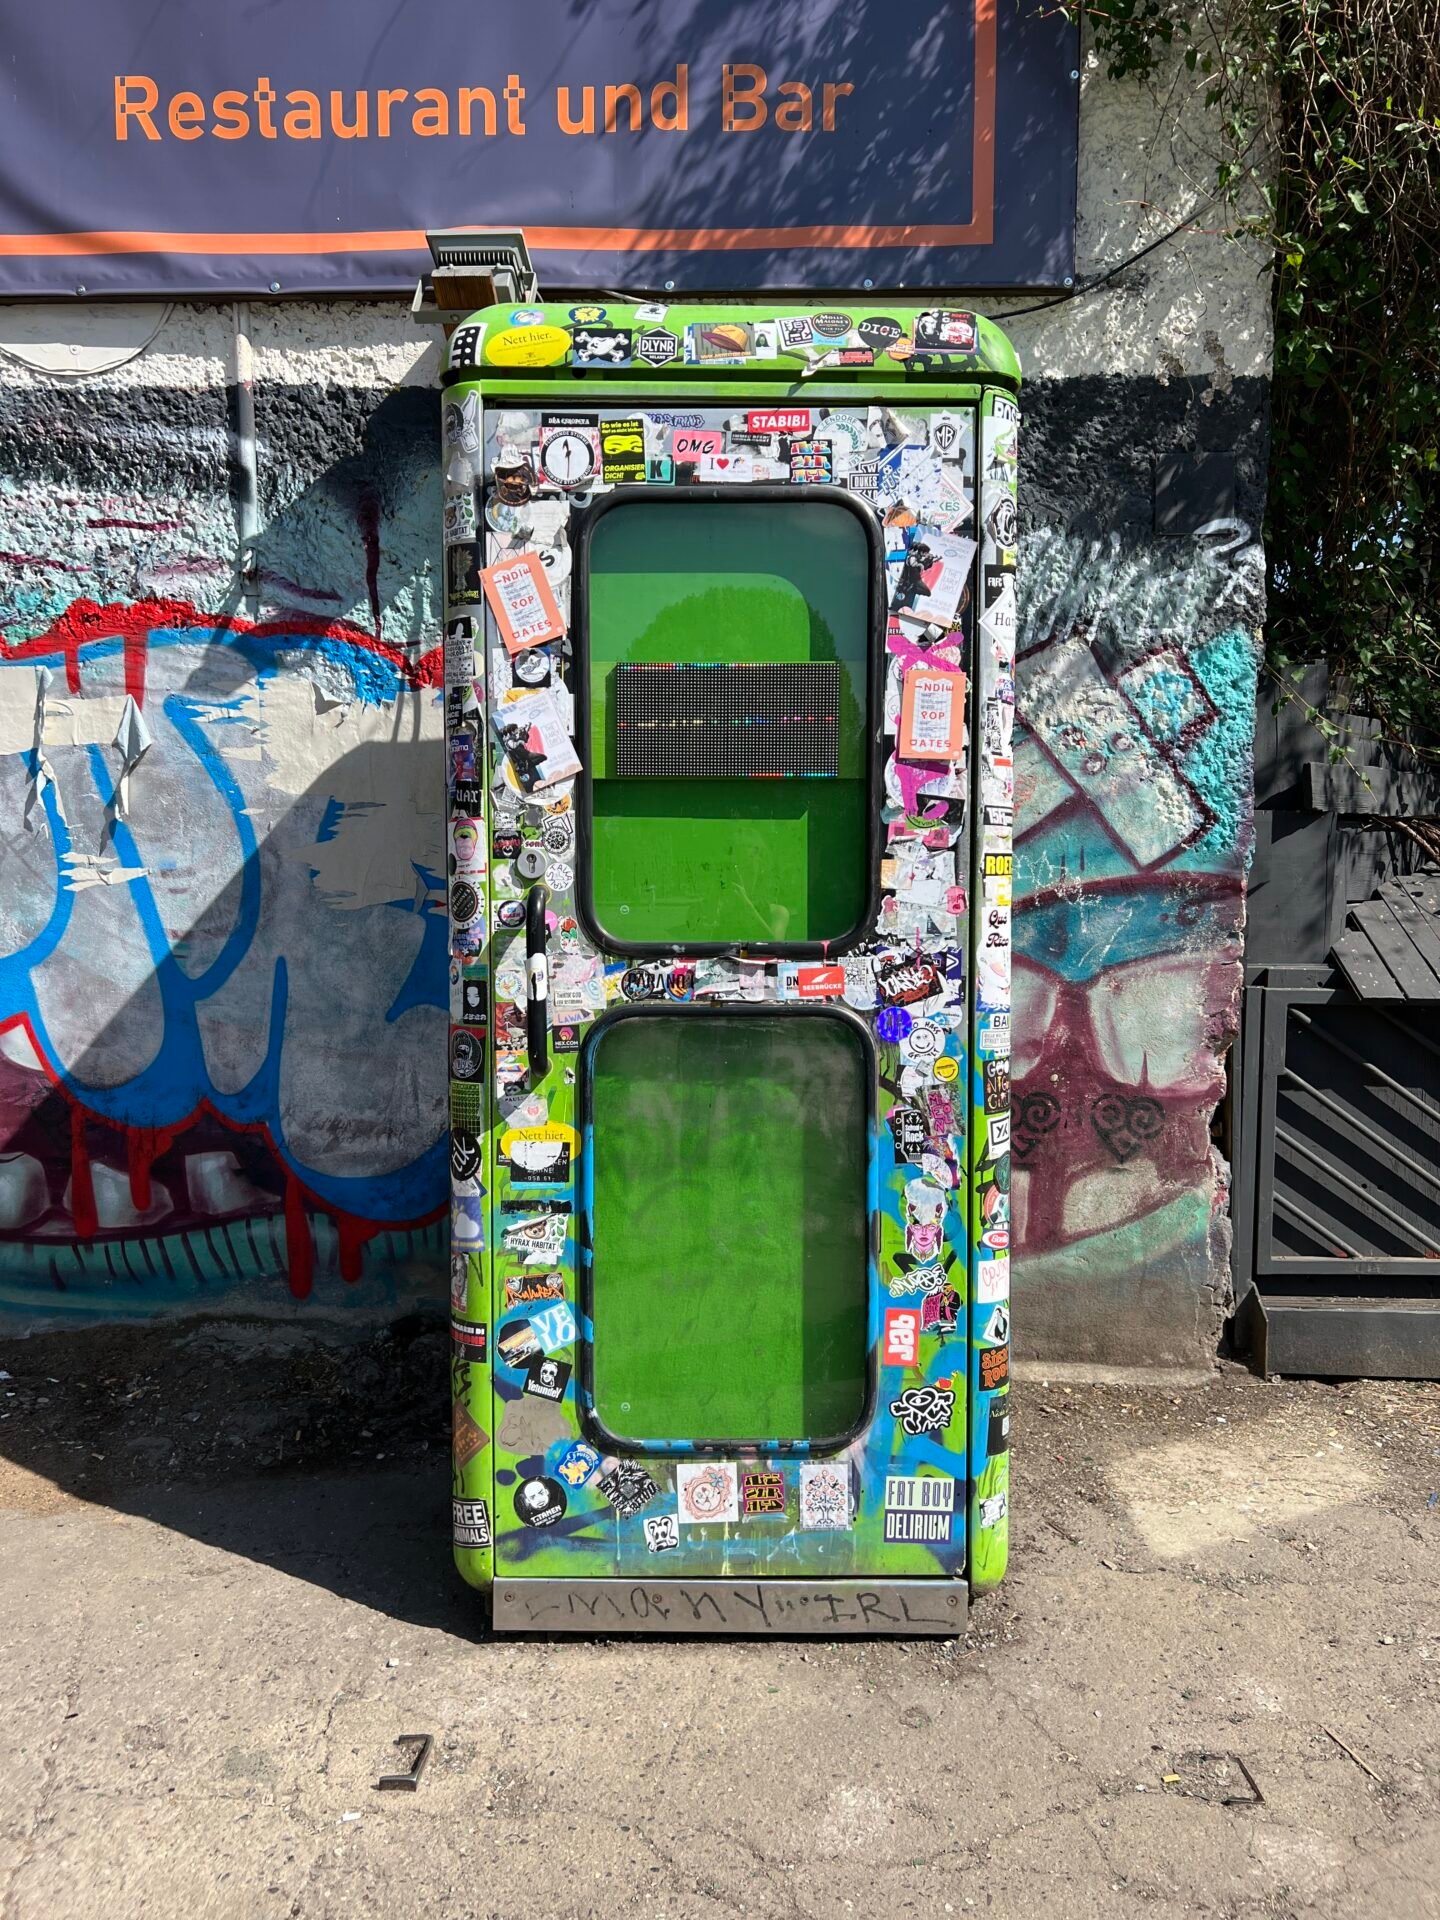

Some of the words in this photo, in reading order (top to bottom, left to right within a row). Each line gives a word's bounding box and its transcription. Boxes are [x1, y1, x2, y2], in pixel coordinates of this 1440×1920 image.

[114, 74, 525, 142] Restaurant
[555, 63, 689, 135] und
[721, 63, 853, 132] Bar
[858, 321, 901, 339] DICE
[502, 335, 528, 346] Nett
[529, 331, 553, 342] hier.
[641, 339, 675, 352] DLYNR
[752, 413, 806, 429] STABIBI
[677, 438, 715, 454] OMG
[604, 463, 645, 472] ORGANISIER
[604, 472, 625, 480] DICH!
[511, 595, 535, 610] POP
[511, 619, 552, 639] DATES
[920, 711, 945, 720] POP
[909, 738, 952, 748] DATES
[988, 909, 1008, 929] Qué
[985, 932, 1010, 948] Rico
[802, 983, 843, 991] SEEBRÜCKE
[518, 1130, 543, 1140] Nett
[545, 1130, 567, 1140] hier.
[905, 1131, 925, 1143] Rock
[509, 1237, 530, 1248] HYRAX
[531, 1241, 557, 1251] HABITAT
[888, 1314, 916, 1361] Jab
[887, 1480, 916, 1507] FAT
[921, 1481, 952, 1508] BOY
[453, 1500, 483, 1526] FREE
[886, 1512, 951, 1541] DELIRIUM
[454, 1526, 489, 1544] ANIMALS
